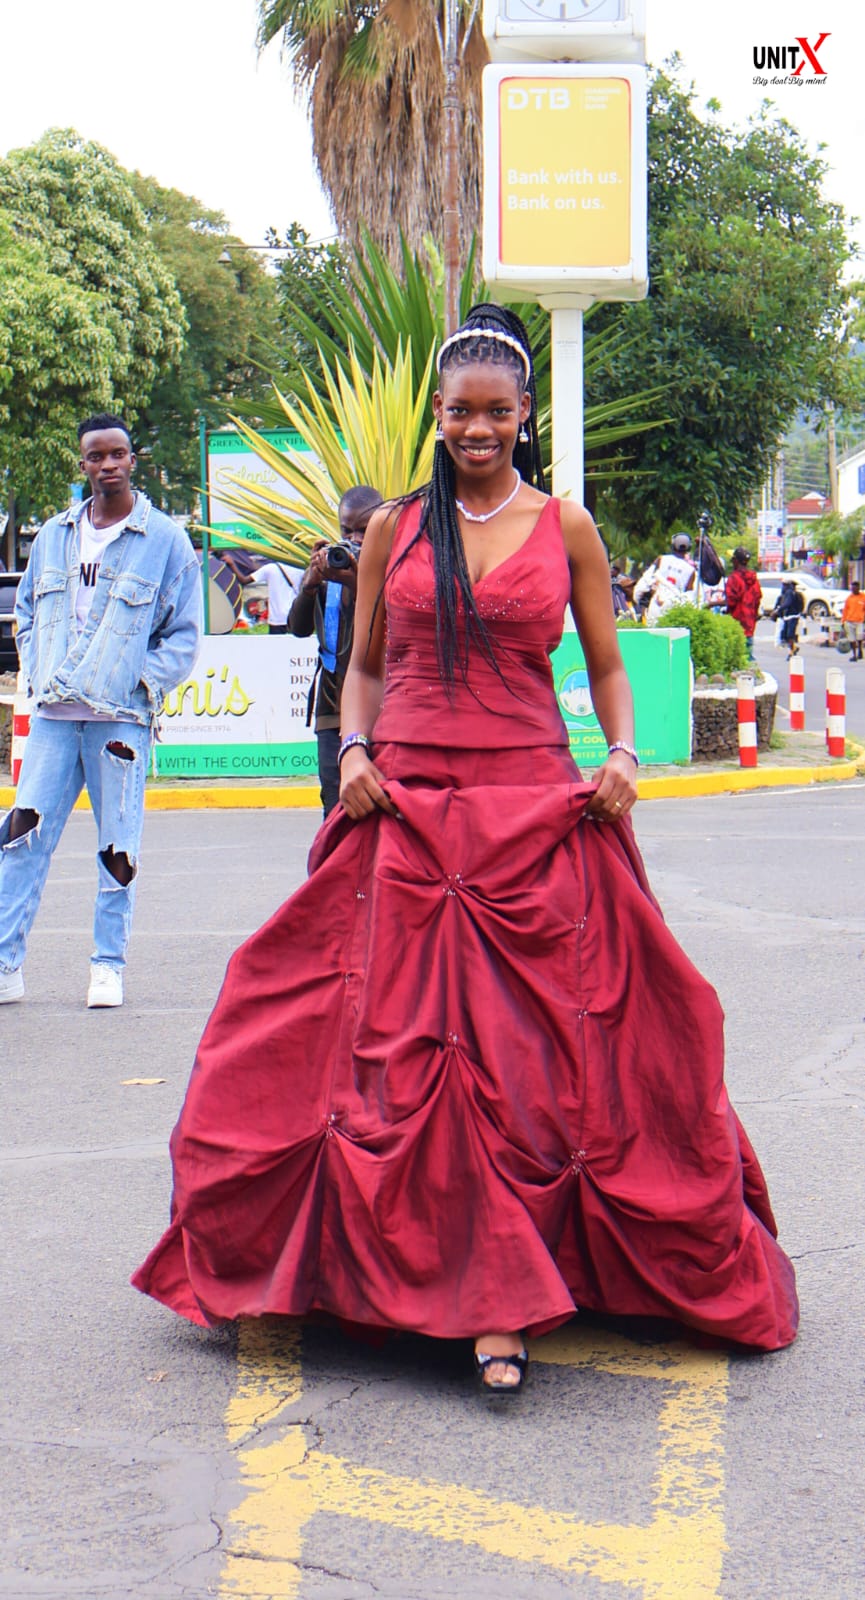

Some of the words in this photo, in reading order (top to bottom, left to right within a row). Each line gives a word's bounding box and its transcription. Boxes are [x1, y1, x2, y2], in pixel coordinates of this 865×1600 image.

[508, 87, 570, 110] DTB
[507, 168, 549, 184] Bank
[554, 168, 593, 184] with
[598, 171, 622, 184] us.
[507, 193, 549, 209] Bank
[554, 197, 576, 209] on
[582, 197, 606, 209] us.
[165, 757, 196, 768] WITH
[203, 756, 228, 768] THE
[232, 755, 288, 768] COUNTY
